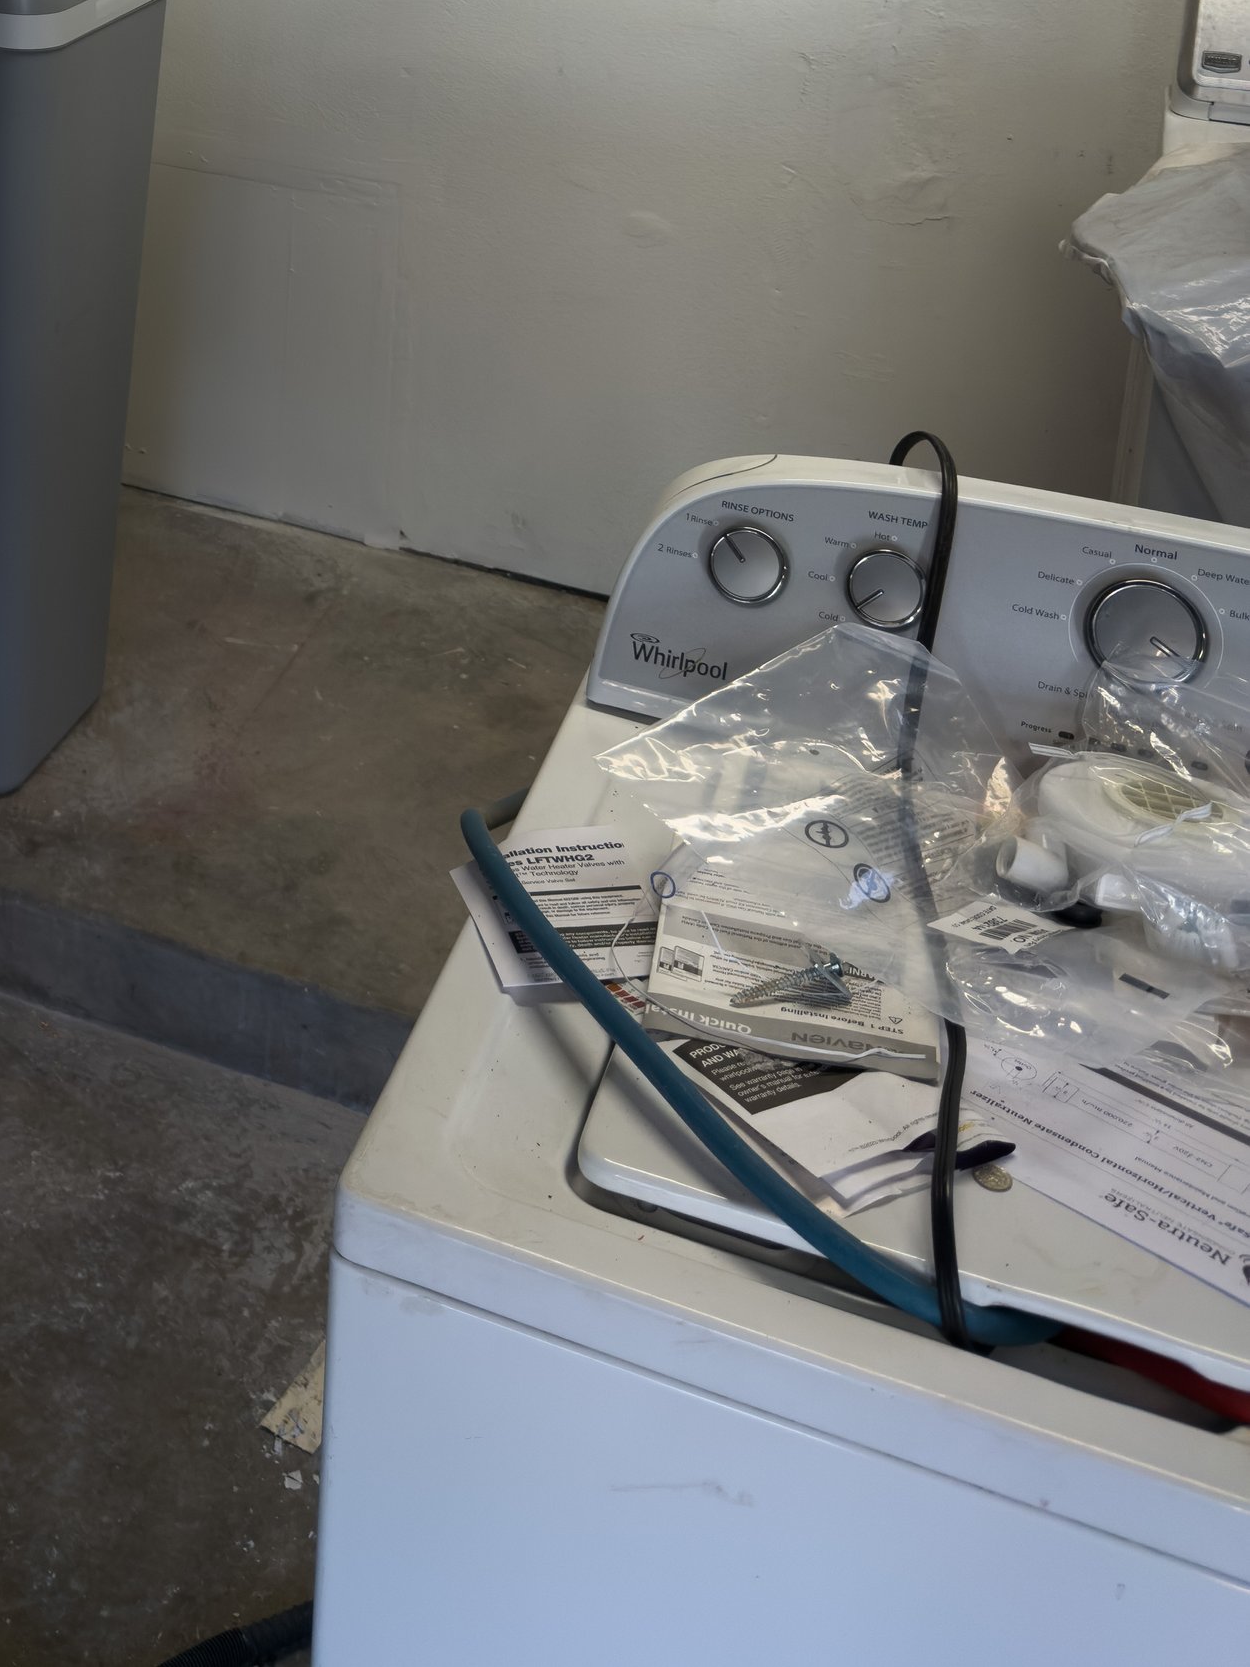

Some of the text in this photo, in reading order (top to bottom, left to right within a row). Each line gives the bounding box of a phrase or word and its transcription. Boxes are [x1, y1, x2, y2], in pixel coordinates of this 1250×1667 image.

[722, 500, 794, 522] RINSE OPTIONS
[690, 514, 713, 526] Rinse
[868, 510, 928, 529] WASH TEMP
[824, 536, 849, 548] Warm
[874, 532, 891, 541] Hot
[658, 543, 692, 558] 2 Rinses
[1082, 546, 1112, 559] Casual
[1134, 544, 1177, 560] Normal
[808, 571, 828, 581] Cool
[1038, 571, 1075, 585] Delicate
[1197, 568, 1250, 585] Deep Wate
[818, 611, 839, 622] Cold
[1012, 604, 1060, 620] Cold Wash
[1229, 610, 1250, 621] Bulk
[632, 641, 727, 680] Whirlpool
[1038, 681, 1062, 693] Drain
[1065, 687, 1071, 695] &
[1021, 721, 1051, 733] Progress
[503, 841, 624, 859] allation Instructio
[527, 854, 594, 865] LFTWHG2
[549, 862, 577, 870] Heater
[578, 861, 605, 869] Valves
[529, 869, 579, 877] Technology
[780, 1006, 828, 1019] Installing
[700, 1014, 752, 1035] Quick
[831, 1015, 865, 1027] Before
[878, 1026, 904, 1035] STEP
[690, 1044, 725, 1059] PROD
[701, 1054, 724, 1068] AND
[711, 1064, 737, 1075] Please
[730, 1082, 746, 1091] See
[747, 1073, 776, 1085] warranty
[738, 1084, 767, 1097] owner's
[769, 1076, 791, 1086] manual
[745, 1082, 802, 1102] warranty details.
[969, 1089, 1216, 1221] Vertical/Horizontal Condensate Neutralizer
[1135, 1156, 1162, 1172] Manual
[1104, 1194, 1232, 1266] Neutra-Safe
